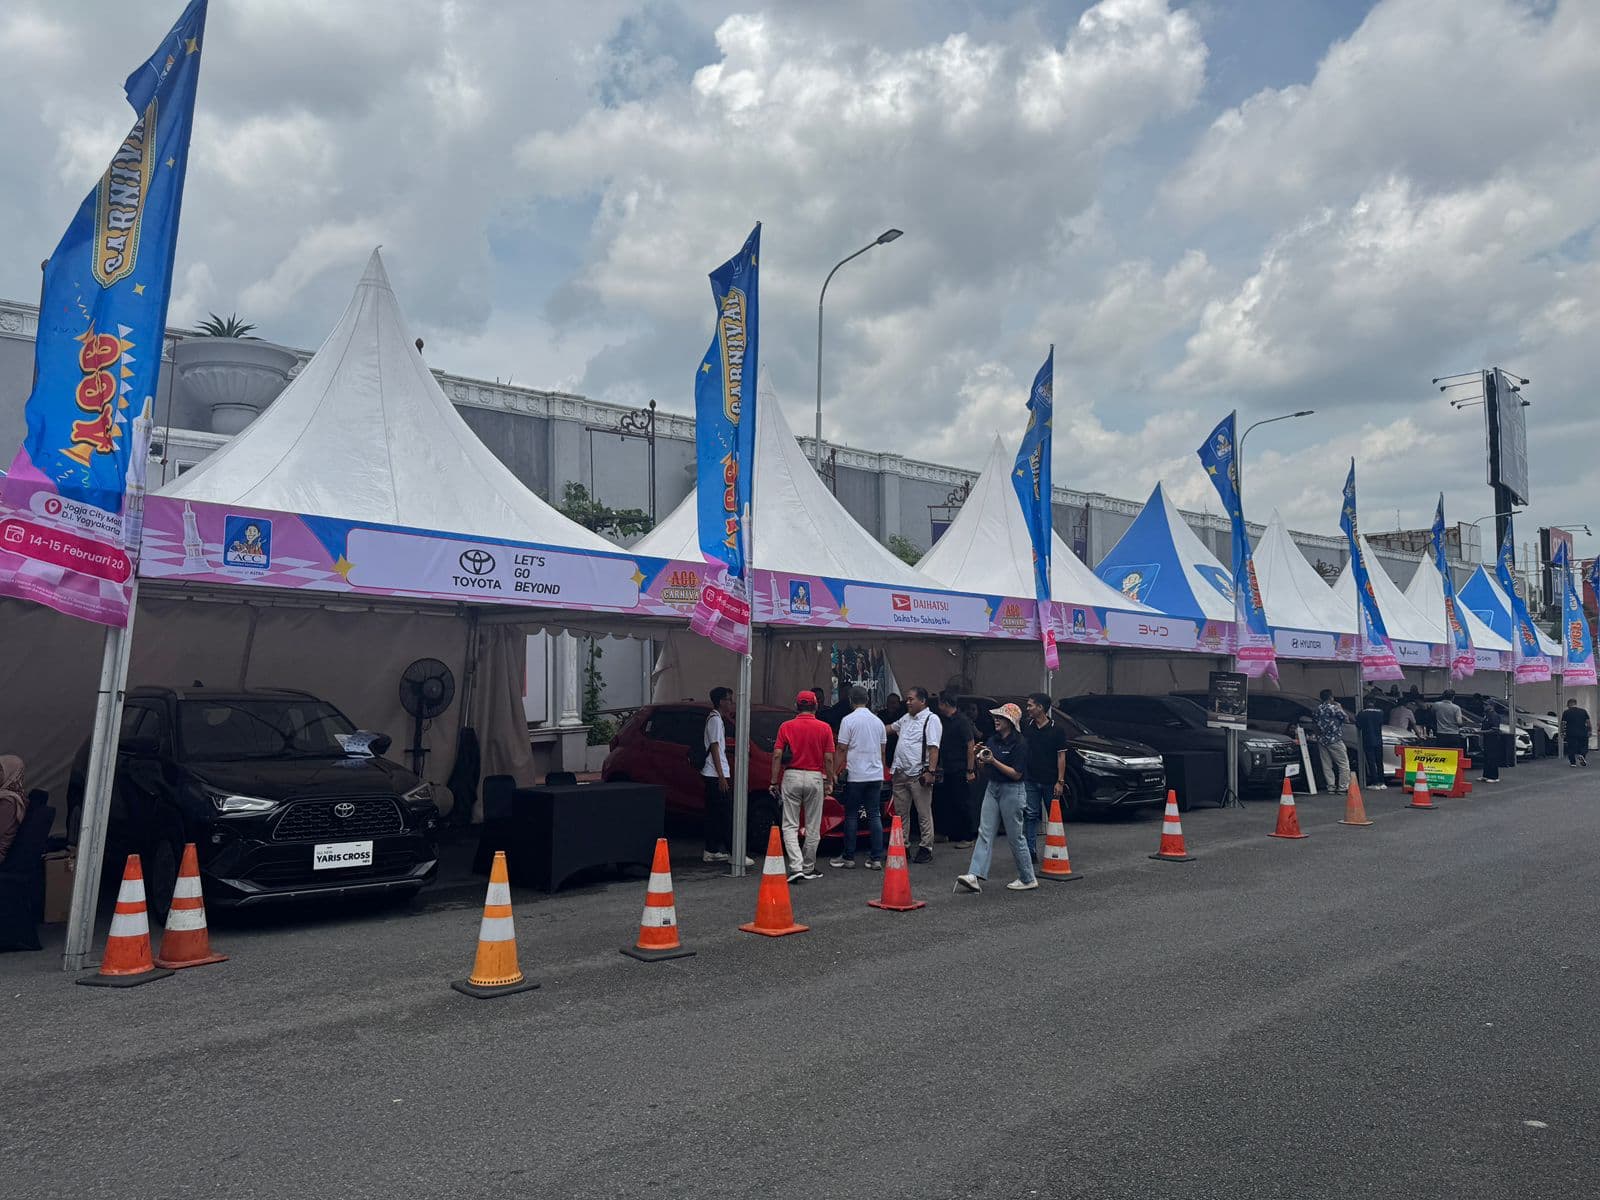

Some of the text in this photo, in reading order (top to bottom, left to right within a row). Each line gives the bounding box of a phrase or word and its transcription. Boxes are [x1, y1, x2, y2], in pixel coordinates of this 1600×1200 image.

[71, 333, 122, 456] ACC
[64, 502, 87, 517] Jogja
[89, 508, 106, 521] City
[76, 515, 121, 535] Yogyakarta
[30, 534, 61, 551] 14-15
[63, 544, 111, 565] Februari
[233, 553, 262, 562] ACC
[514, 554, 546, 567] LET'S
[514, 567, 531, 579] GO
[452, 575, 502, 590] TOYOTA
[514, 581, 560, 595] BEYOND
[663, 589, 699, 601] CARNIVA
[913, 599, 949, 611] DAIHATSU
[1138, 624, 1169, 637] BYD
[1414, 755, 1446, 763] POWER
[317, 851, 370, 863] YARIS CROSS
